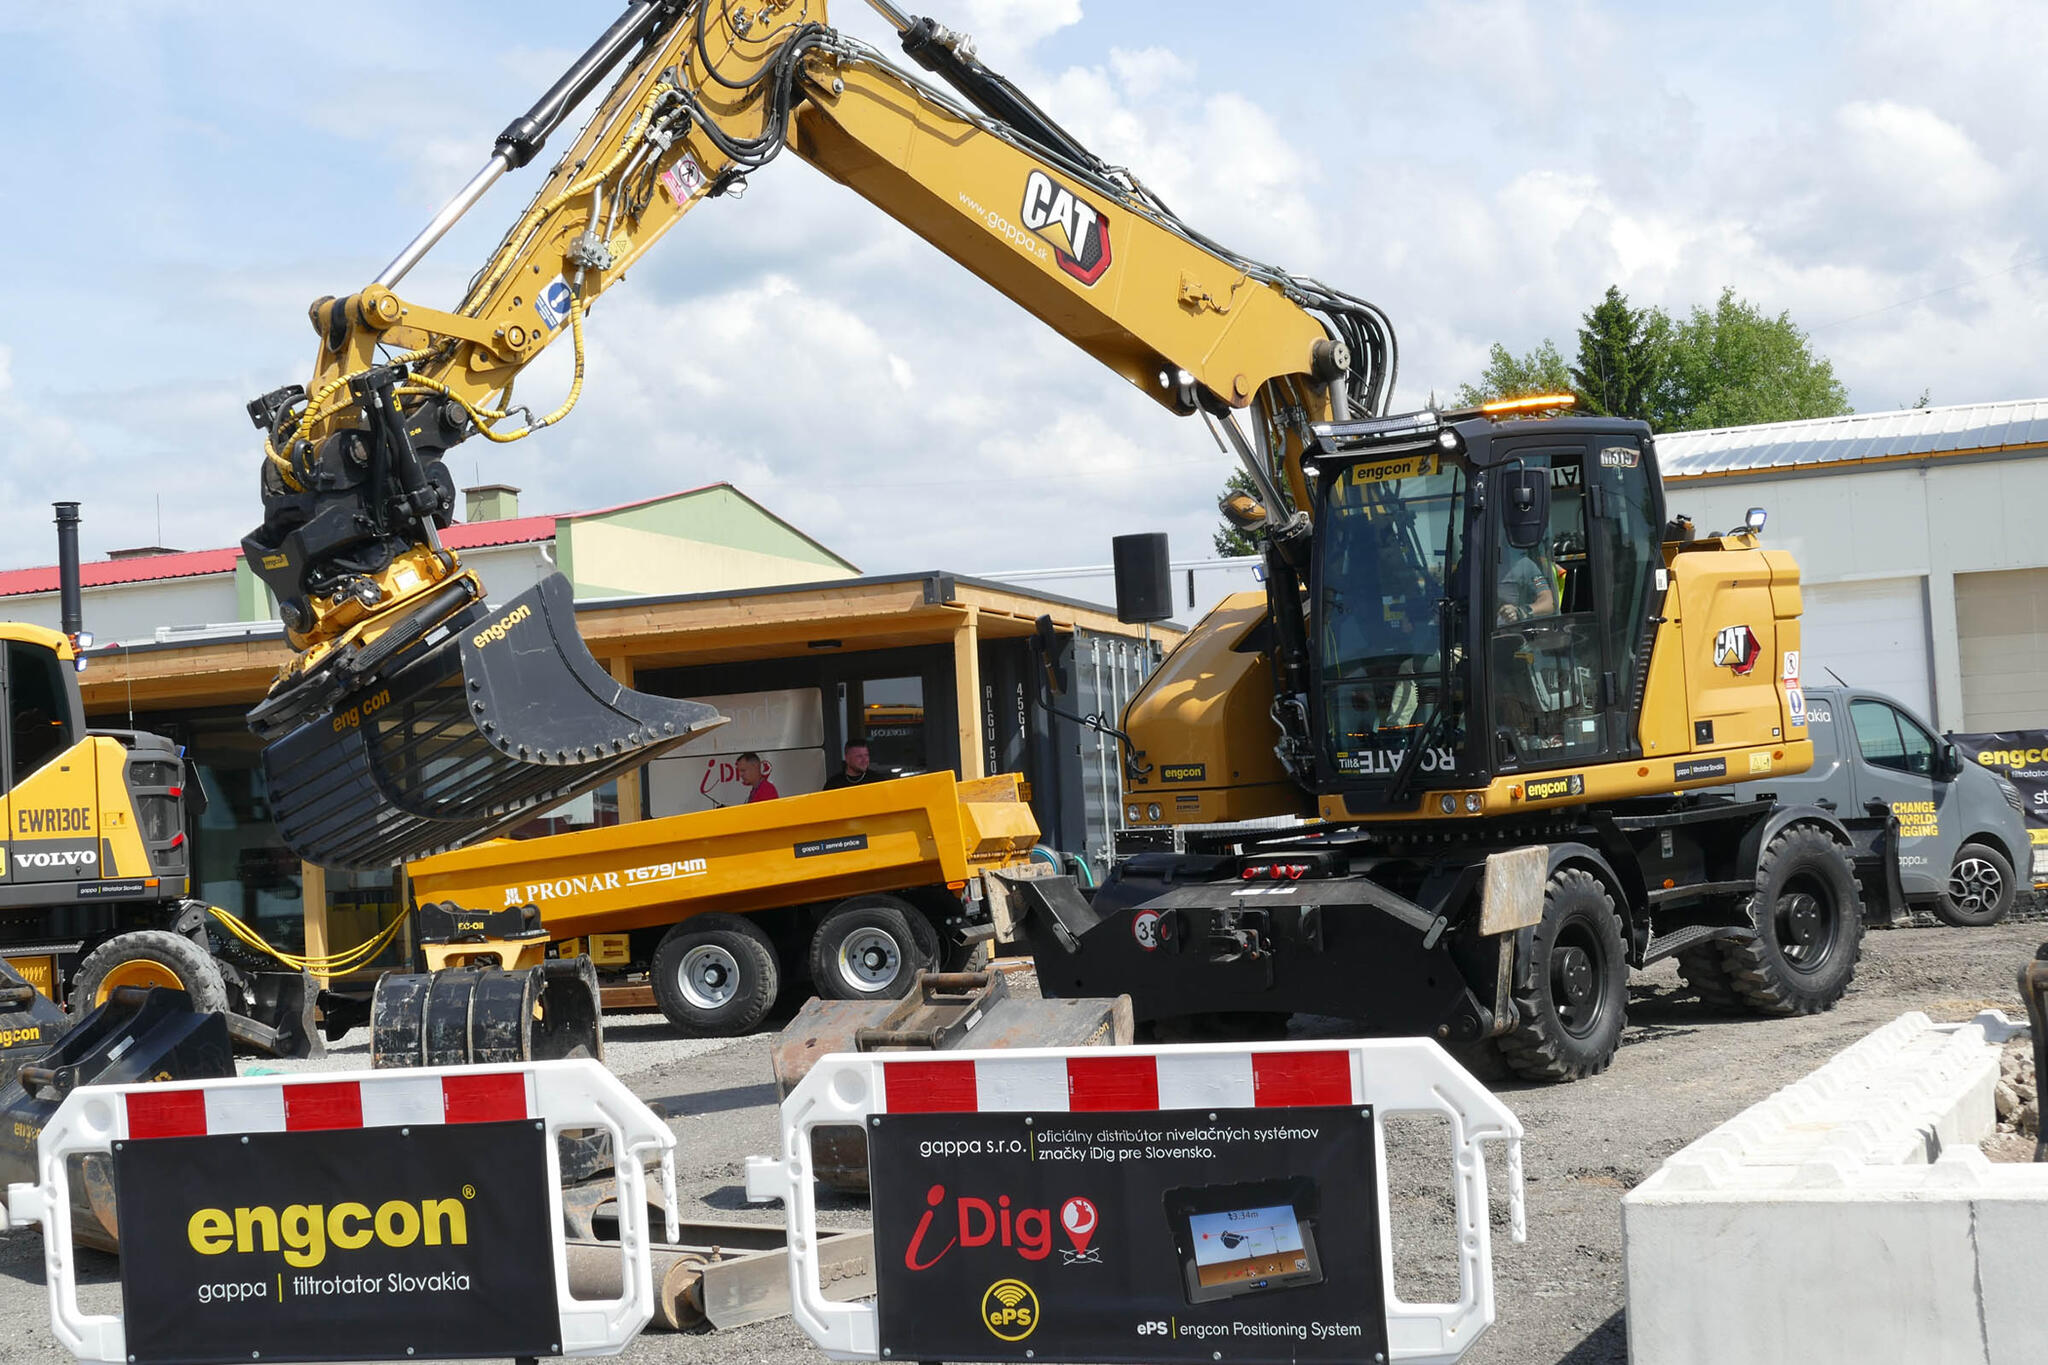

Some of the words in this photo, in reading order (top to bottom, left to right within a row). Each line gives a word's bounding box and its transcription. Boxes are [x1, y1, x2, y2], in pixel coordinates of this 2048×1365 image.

[958, 191, 1047, 261] www.gappa.sk
[1022, 170, 1098, 262] CAT
[1357, 461, 1411, 482] engcon
[473, 604, 531, 649] engcon
[1715, 627, 1746, 664] CAT
[985, 685, 995, 741] RLGU
[1016, 682, 1025, 739] 45G1
[1807, 709, 1831, 722] akia
[1358, 747, 1455, 774] ROATE
[700, 759, 751, 793] iDi
[1165, 767, 1201, 779] engcon
[1528, 778, 1567, 799] engcon
[1892, 801, 1936, 813] CHANGE
[18, 807, 91, 833] EWR130E
[1900, 826, 1938, 837] IGGING
[14, 850, 96, 867] VOLVO
[526, 872, 621, 903] PRONAR
[1037, 1128, 1092, 1146] oficiálny
[1097, 1127, 1163, 1143] distribútor
[1166, 1126, 1250, 1143] nivelačných
[1254, 1126, 1319, 1143] systémov
[920, 1139, 981, 1158] gappa
[987, 1139, 1027, 1154] s.r.o.
[1039, 1146, 1086, 1163] značky
[1090, 1145, 1115, 1162] iDig
[1118, 1149, 1142, 1162] pre
[1146, 1145, 1217, 1160] Slovensko.
[198, 1280, 266, 1303] gappa
[293, 1275, 382, 1297] tiltrotator
[388, 1271, 470, 1293] Slovakia
[990, 1308, 1031, 1327] ePS
[1136, 1321, 1168, 1336] ePS
[1180, 1324, 1230, 1340] engcon
[1234, 1321, 1307, 1340] Positioning
[1311, 1322, 1362, 1340] System
